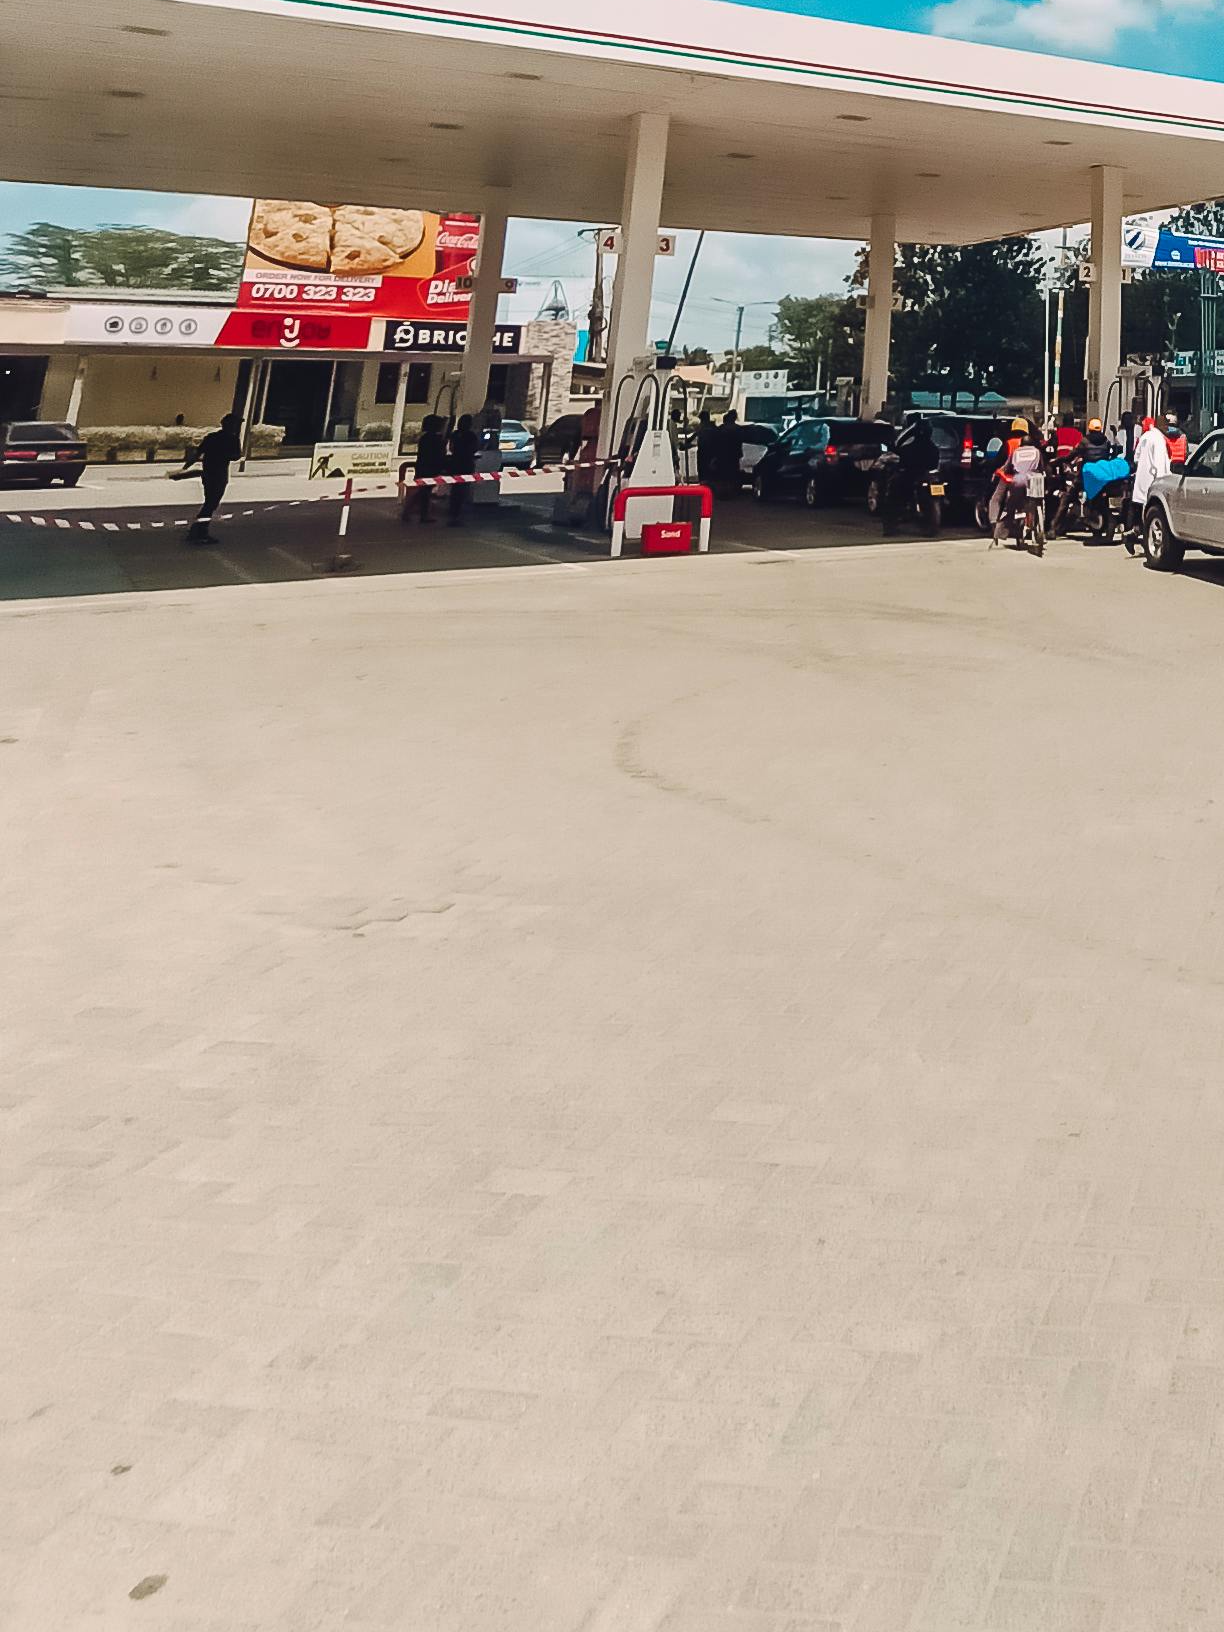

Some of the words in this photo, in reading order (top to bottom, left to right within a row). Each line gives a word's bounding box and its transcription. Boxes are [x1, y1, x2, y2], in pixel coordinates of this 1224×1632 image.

[603, 236, 614, 249] 4
[660, 238, 670, 252] 3
[1083, 266, 1091, 277] 2
[1121, 268, 1126, 280] 1
[255, 272, 287, 282] ORDER
[290, 274, 312, 282] NOW
[313, 274, 332, 282] FOR
[334, 275, 376, 284] DELIVERY
[251, 284, 298, 299] 0700
[302, 286, 336, 300] 323
[341, 287, 375, 302] 323
[352, 452, 389, 460] CAUTION
[660, 529, 682, 538] Sand
